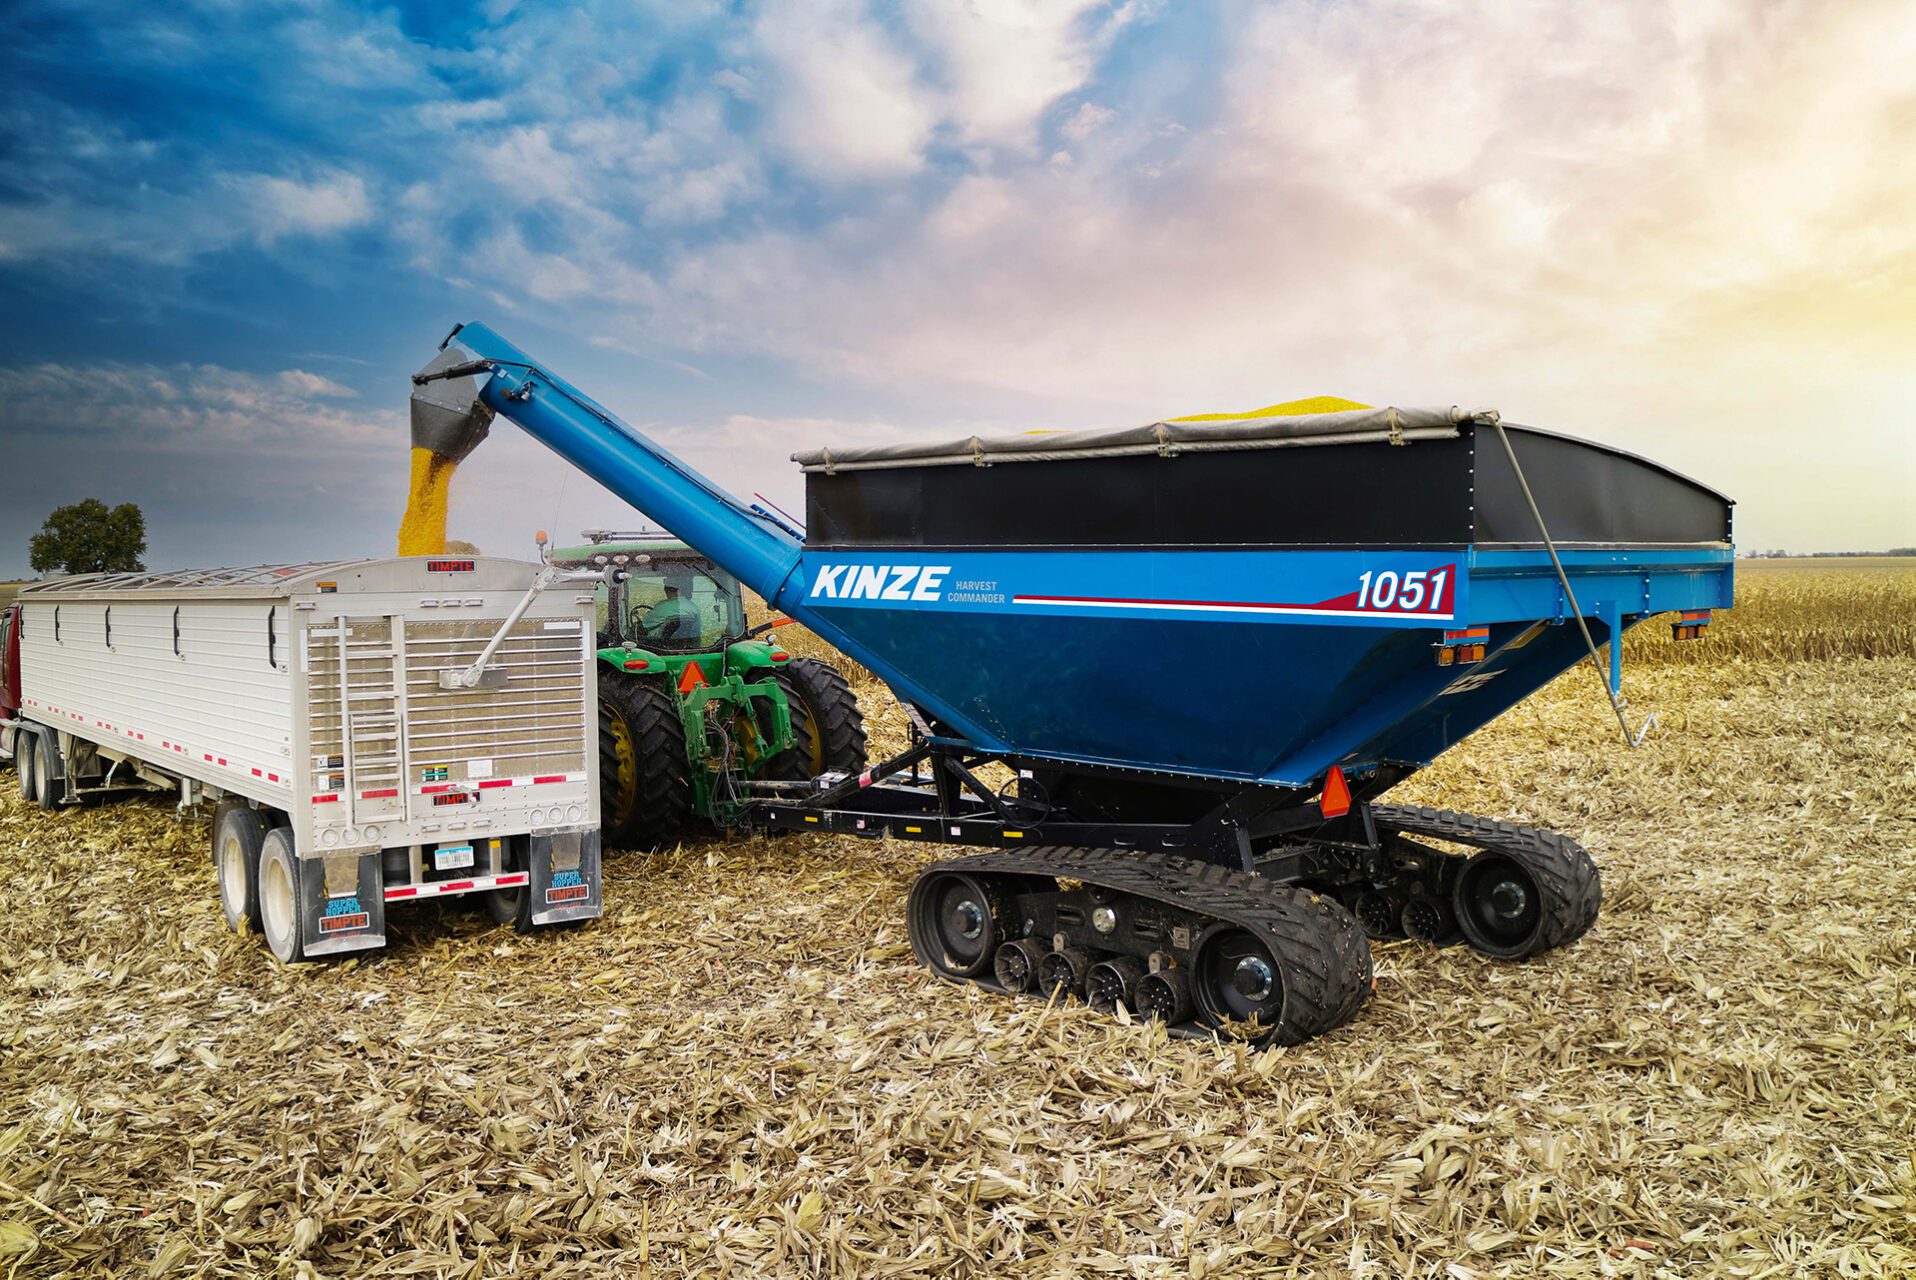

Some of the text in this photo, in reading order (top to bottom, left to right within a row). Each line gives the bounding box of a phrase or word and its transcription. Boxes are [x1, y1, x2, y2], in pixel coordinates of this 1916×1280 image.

[428, 561, 472, 571] TIMPTE
[810, 565, 952, 601] KINZE
[955, 580, 997, 591] HARVEST
[1357, 570, 1448, 610] 1051
[947, 592, 1005, 604] COMMANDER
[554, 871, 580, 881] SUPER
[551, 878, 582, 889] HOPPER
[548, 886, 586, 901] TIMPTE
[327, 897, 358, 908] SUPER
[325, 904, 361, 917] HOPPER
[322, 913, 366, 930] TIMPTE
